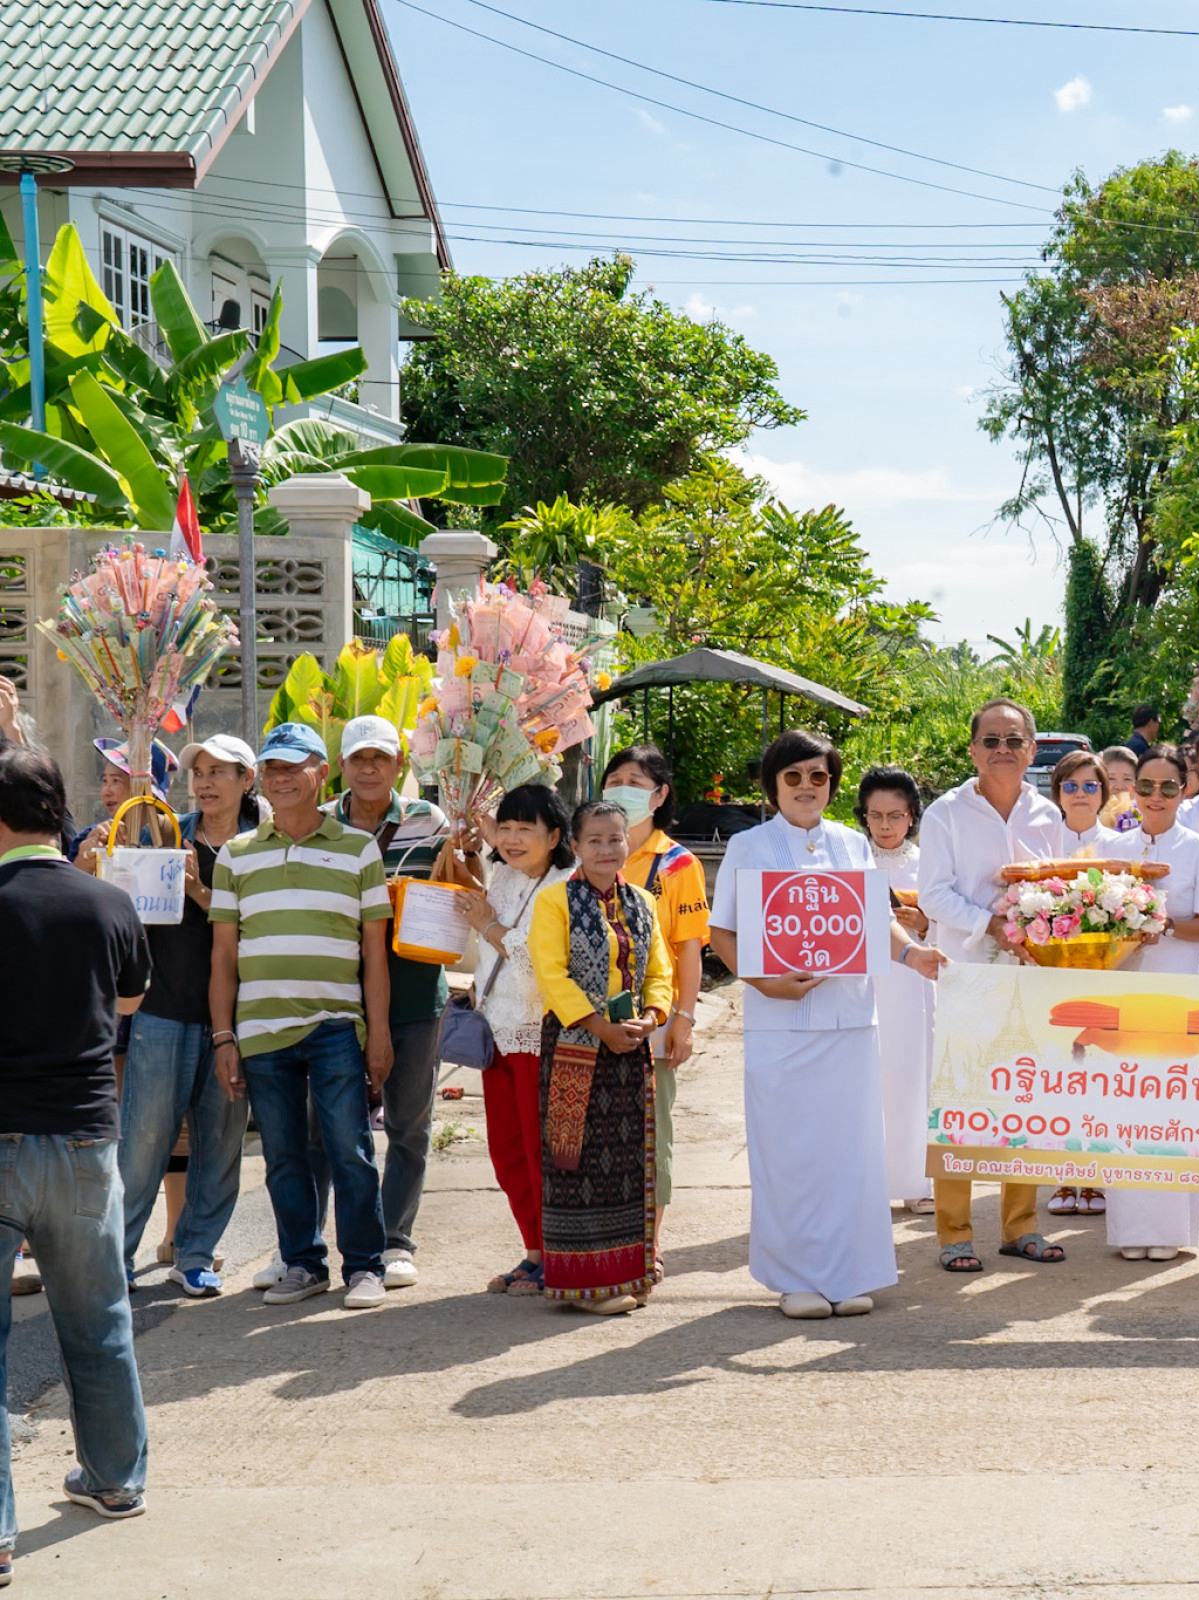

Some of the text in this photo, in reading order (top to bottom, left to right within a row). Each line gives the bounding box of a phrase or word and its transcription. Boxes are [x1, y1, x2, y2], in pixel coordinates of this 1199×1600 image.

[788, 877, 840, 911] กฐิน
[767, 914, 862, 938] 30,000
[798, 941, 830, 967] วัด
[942, 1107, 1072, 1138] ๓๐,๐๐๐
[1081, 1117, 1109, 1140] วัด
[944, 1155, 973, 1171] โดย
[1103, 1168, 1173, 1184] บูชาธรรม
